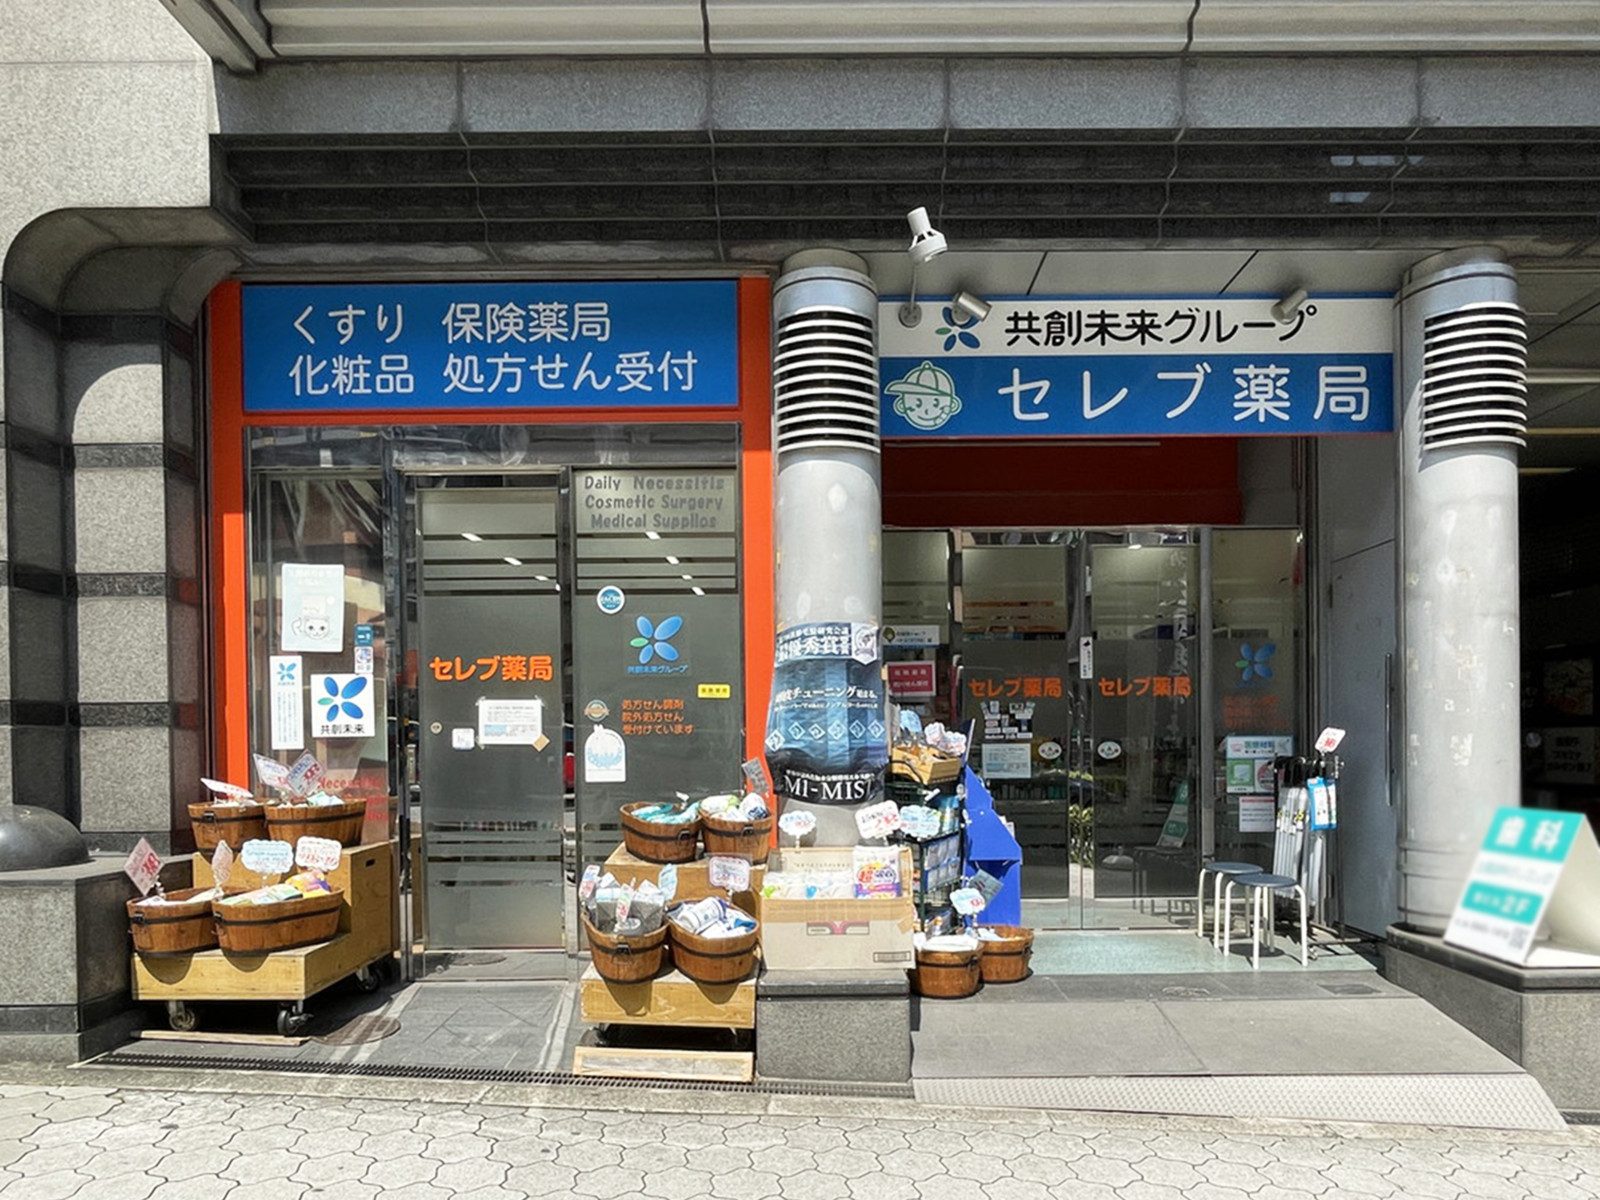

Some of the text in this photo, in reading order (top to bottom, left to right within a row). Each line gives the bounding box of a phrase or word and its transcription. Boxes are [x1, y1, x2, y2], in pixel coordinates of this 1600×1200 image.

[293, 302, 612, 345] くすり 保険薬局
[1004, 304, 1318, 348] 共創未来グループ
[289, 350, 699, 396] 化粧品 処方せん受付
[998, 361, 1371, 423] セレブ薬局
[585, 475, 621, 490] Daily
[585, 494, 724, 510] Cosmetic Surgery
[590, 513, 647, 528] Medical
[429, 655, 553, 682] セレブ薬局
[968, 677, 1063, 698] セレブ薬局
[1098, 676, 1192, 698] セレブ薬局
